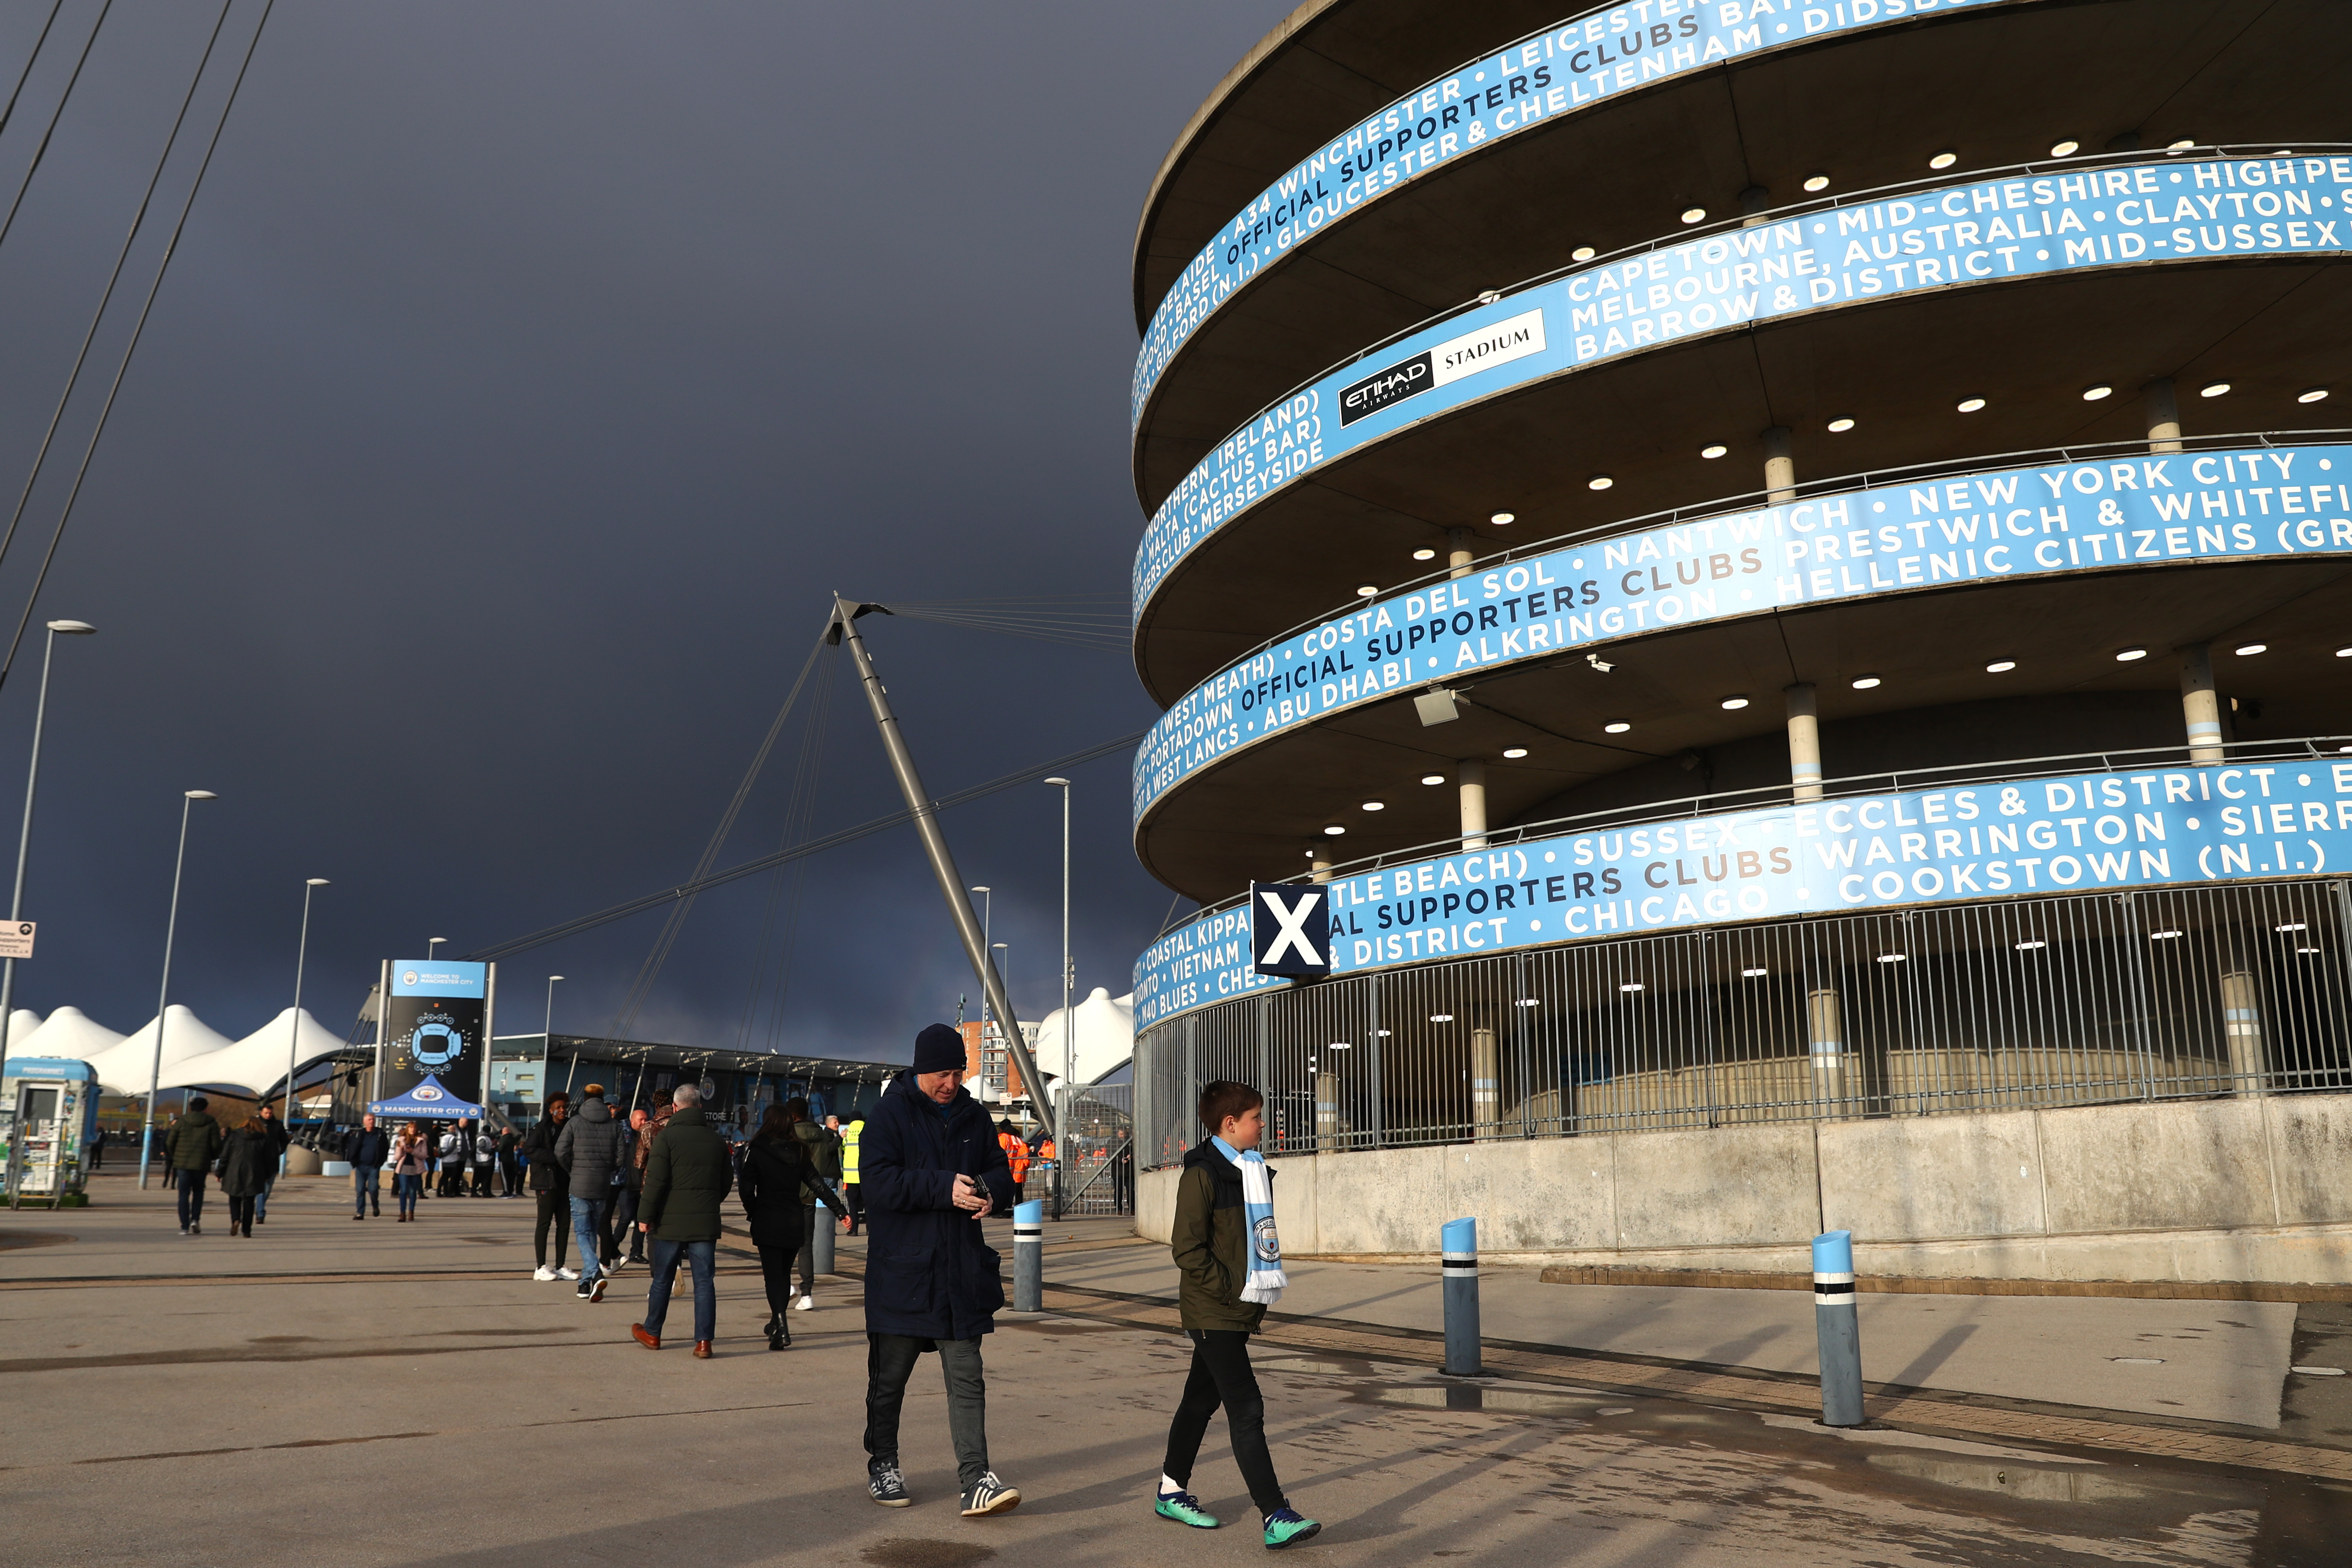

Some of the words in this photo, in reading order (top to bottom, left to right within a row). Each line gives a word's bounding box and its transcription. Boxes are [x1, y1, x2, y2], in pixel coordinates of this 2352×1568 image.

[1157, 296, 1208, 371] GILFORD
[1212, 252, 1259, 305] (N.I.)
[1277, 132, 1458, 250] GLOUCESTER
[1467, 120, 1487, 144] &
[1495, 28, 1762, 131] CHELTENHAM
[1803, 0, 1968, 34] DIDS
[1227, 180, 1329, 265] OFFICIAL
[1341, 66, 1551, 183] SUPPORTERS
[1570, 15, 1698, 73] CLUBS
[1154, 242, 1215, 335] ADELAIDE
[1234, 199, 1271, 239] A34
[1278, 78, 1461, 198] WINCHESTER
[1568, 257, 1669, 301] CAPE
[1675, 221, 1803, 271] TOWN
[1838, 168, 2160, 236] MID-CHESHIRE
[2194, 160, 2297, 188] HIGH
[1176, 264, 1220, 323] BASEL
[1572, 249, 1831, 331] MELBOURNE,
[1843, 208, 2087, 267] AUSTRALIA
[2116, 190, 2312, 226] CLAYTON
[1575, 291, 1759, 361] BARROW
[1772, 285, 1798, 310] &
[1809, 245, 2020, 303] DISTRICT
[2064, 220, 2342, 264] MID-SUSSEX
[1345, 363, 1426, 408] ETIHAD
[1362, 383, 1411, 409] AIRWAYS
[1446, 328, 1530, 369] STADIUM
[1145, 461, 1209, 546] (NORTHERN
[1219, 389, 1319, 469] IRELAND)
[1149, 514, 1178, 561] MALTA
[1184, 453, 1254, 523] (CACTUS
[1265, 415, 1321, 463] BAR)
[1162, 528, 1190, 568] CLUB
[1202, 438, 1324, 532] MERSEYSIDE
[1785, 505, 2068, 567] PRESTWICH
[2097, 498, 2125, 526] &
[1160, 693, 1198, 741] (WEST
[1204, 653, 1274, 706] MEATH)
[1303, 607, 1392, 657] COSTA
[1405, 583, 1469, 621] DEL
[1483, 561, 1554, 599] SOL
[1604, 499, 1849, 570] NANTWICH
[1909, 476, 2019, 515] NEW
[2039, 460, 2174, 498] YORK
[2192, 453, 2295, 484] CITY
[1242, 649, 1354, 711] OFFICIAL
[1368, 580, 1600, 662] SUPPORTERS
[1621, 548, 1762, 596] CLUBS
[1146, 783, 1151, 802] &
[1153, 756, 1181, 794] WEST
[1186, 723, 1238, 769] LANCS
[1263, 691, 1310, 731] ABU
[1322, 657, 1412, 708] DHABI
[1455, 587, 1717, 668] ALKRINGTON
[1776, 545, 2012, 602] HELLENIC
[2034, 523, 2256, 567] CITIZENS
[1151, 698, 1232, 773] PORTADOWN
[1328, 875, 1383, 910] TLE
[1394, 850, 1527, 896] BEACH)
[1573, 818, 1742, 865] SUSSEX
[1794, 791, 1980, 837] ECCLES
[1999, 787, 2027, 816] &
[2045, 768, 2275, 812] DISTRICT
[1378, 868, 1622, 929] SUPPORTERS
[1645, 846, 1792, 889] CLUBS
[1814, 811, 2166, 870] WARRINGTON
[1146, 930, 1193, 972] COASTAL
[1259, 892, 1324, 965] X
[1354, 916, 1508, 965] DISTRICT
[1564, 885, 1769, 933] CHICAGO
[1838, 848, 2171, 903] COOKSTOWN
[2198, 839, 2325, 879] (N.I.)
[1141, 1000, 1156, 1025] M40
[1160, 982, 1196, 1015] BLUES
[1171, 941, 1239, 983] VIETNAM
[384, 1106, 444, 1114] MANCHESTER
[705, 1112, 727, 1120] STORE
